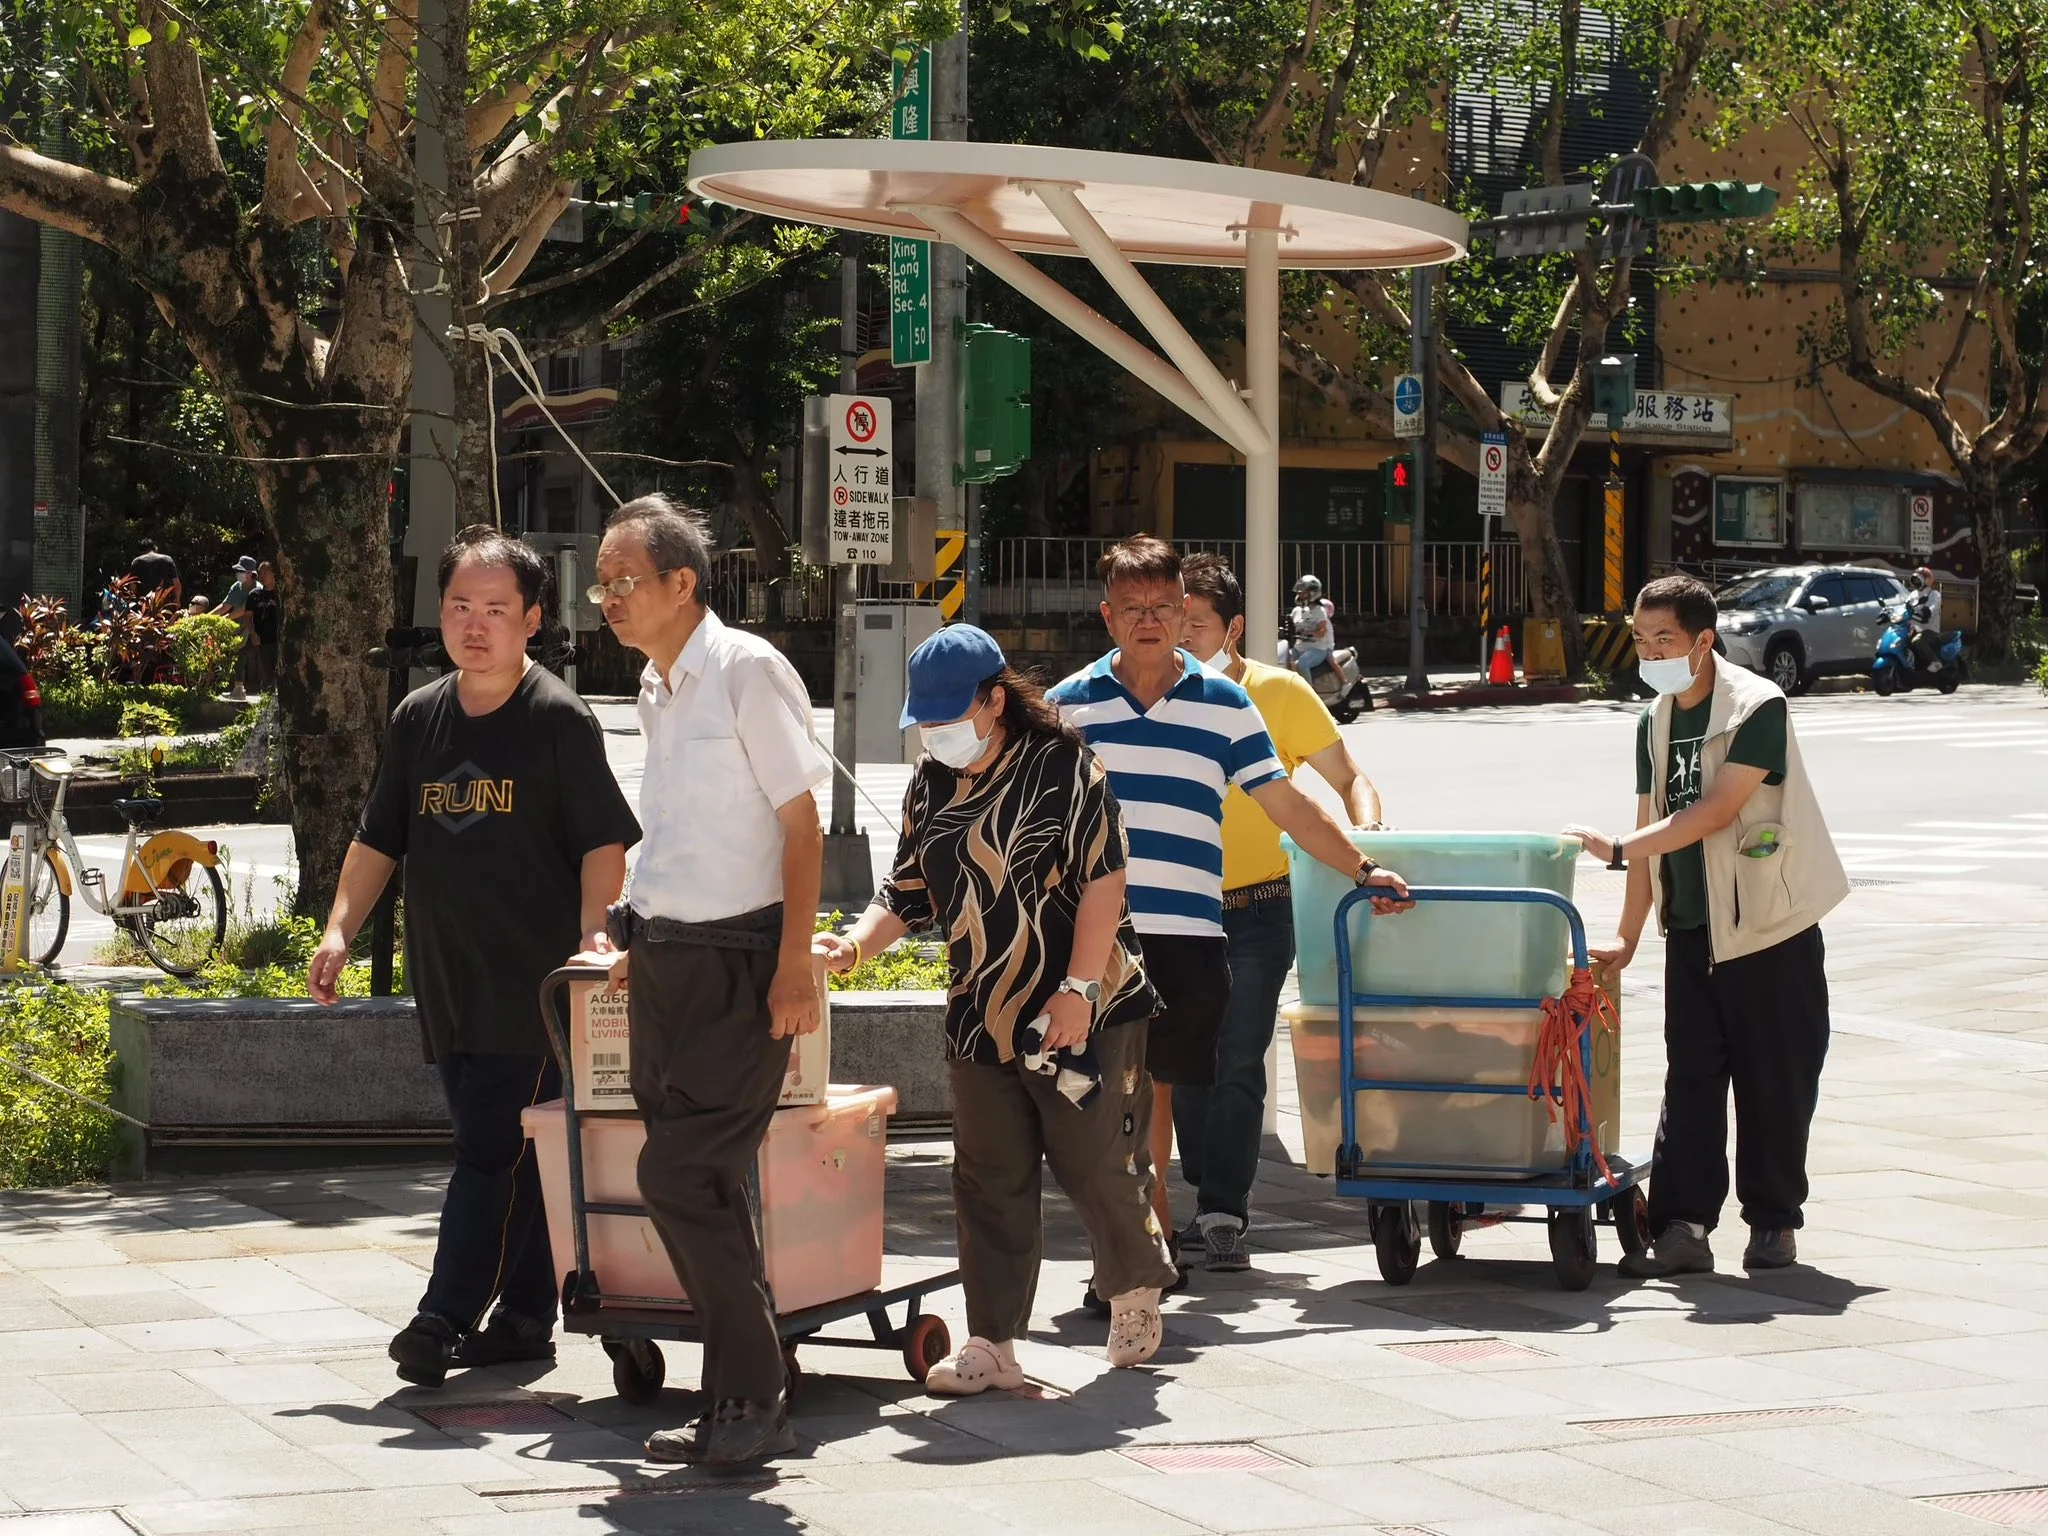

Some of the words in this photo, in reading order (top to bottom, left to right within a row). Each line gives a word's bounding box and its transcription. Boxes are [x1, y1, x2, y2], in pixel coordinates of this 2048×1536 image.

[893, 242, 917, 260] Xing
[893, 261, 919, 278] Long
[893, 278, 909, 295] Rd.
[894, 298, 916, 313] Sec.
[919, 293, 928, 309] 4
[914, 326, 926, 345] 50
[1635, 420, 1673, 430] Service
[1676, 422, 1712, 432] Station
[833, 464, 889, 486] 人行道
[849, 490, 889, 505] SIDEWALK
[833, 509, 890, 530] 違者拖吊
[833, 530, 869, 543] TOW-AWAY
[871, 532, 889, 544] ZONE
[862, 550, 876, 559] 110
[418, 779, 513, 815] RUN
[591, 1029, 629, 1039] LIVING
